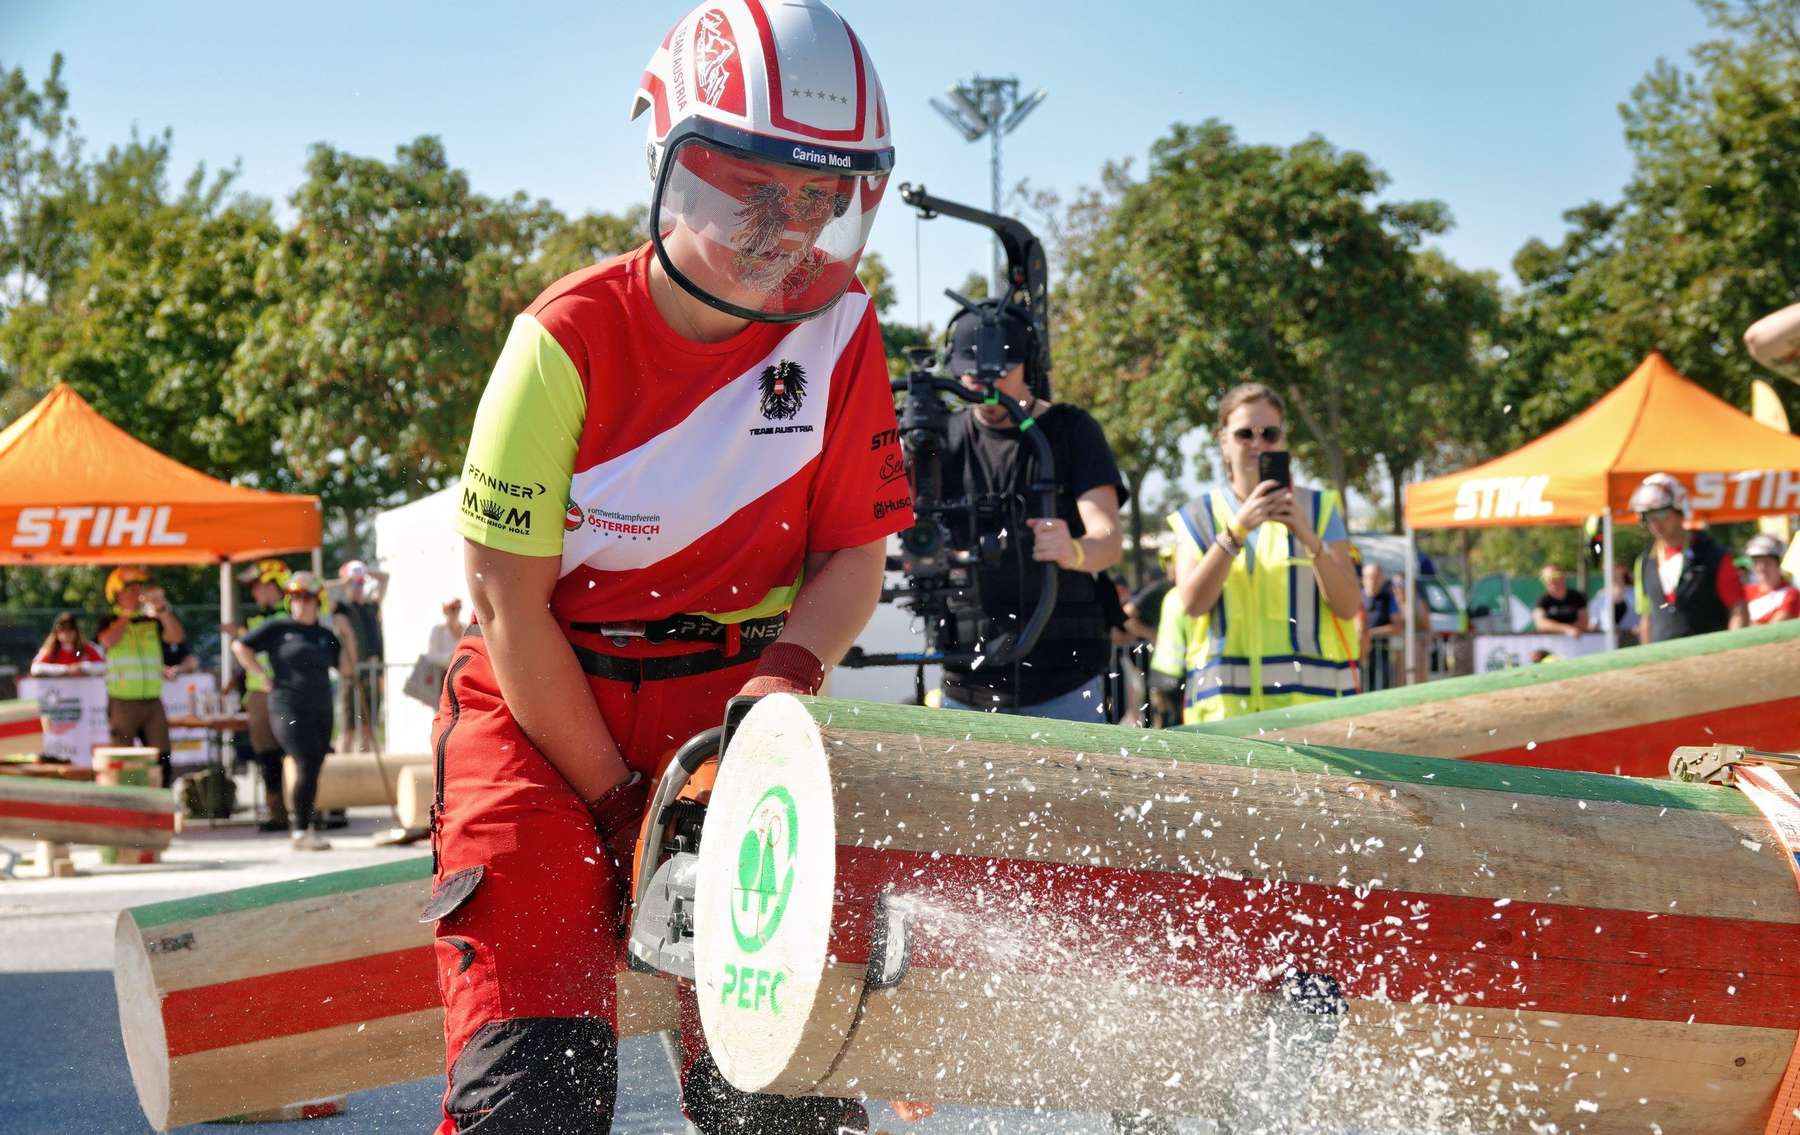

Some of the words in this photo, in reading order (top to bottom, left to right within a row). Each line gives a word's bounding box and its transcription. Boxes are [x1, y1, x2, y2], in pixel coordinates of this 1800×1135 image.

[672, 57, 688, 112] AUSTRIA
[792, 147, 826, 164] Carina
[828, 154, 851, 169] Modl
[749, 427, 774, 436] TEAM
[774, 425, 813, 434] AUSTRIA
[469, 463, 534, 499] PFANNER
[1454, 474, 1553, 520] STIHL
[11, 505, 188, 547] STIHL
[508, 527, 530, 536] HOLZ
[587, 514, 660, 534] ÖSTERREICH
[720, 963, 787, 1016] PEFC
